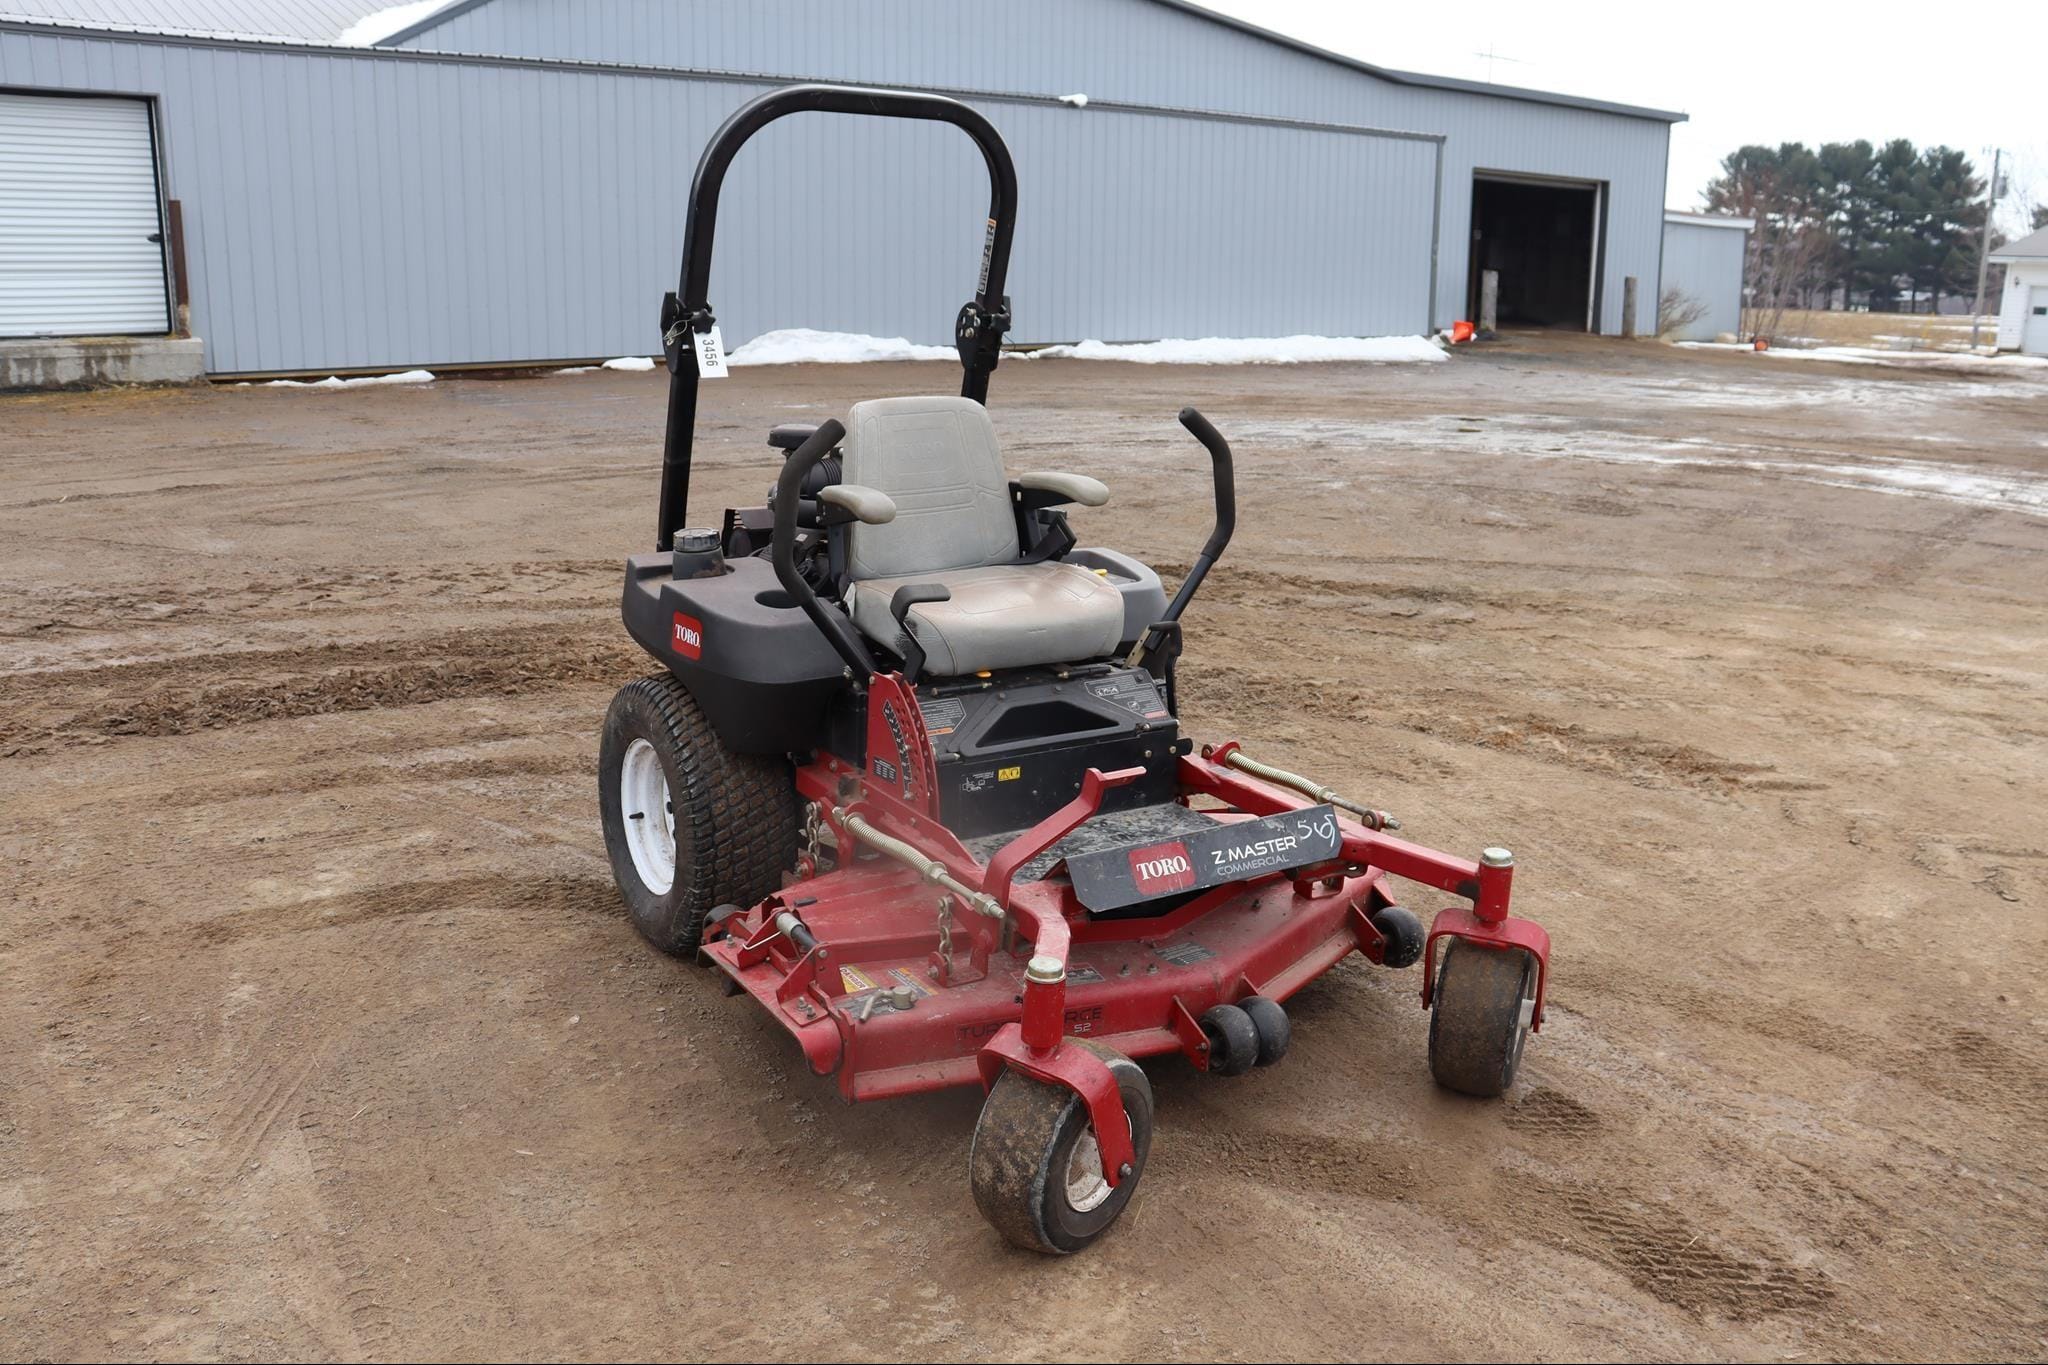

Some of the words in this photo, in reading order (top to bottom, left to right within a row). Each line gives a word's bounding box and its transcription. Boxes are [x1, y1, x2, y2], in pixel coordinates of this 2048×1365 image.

[702, 339, 719, 367] 3456
[674, 623, 700, 648] TORO
[1211, 850, 1226, 865] Z
[1228, 836, 1298, 862] MASTER
[1135, 855, 1188, 880] TORO
[1216, 854, 1290, 876] COMMERCIAL
